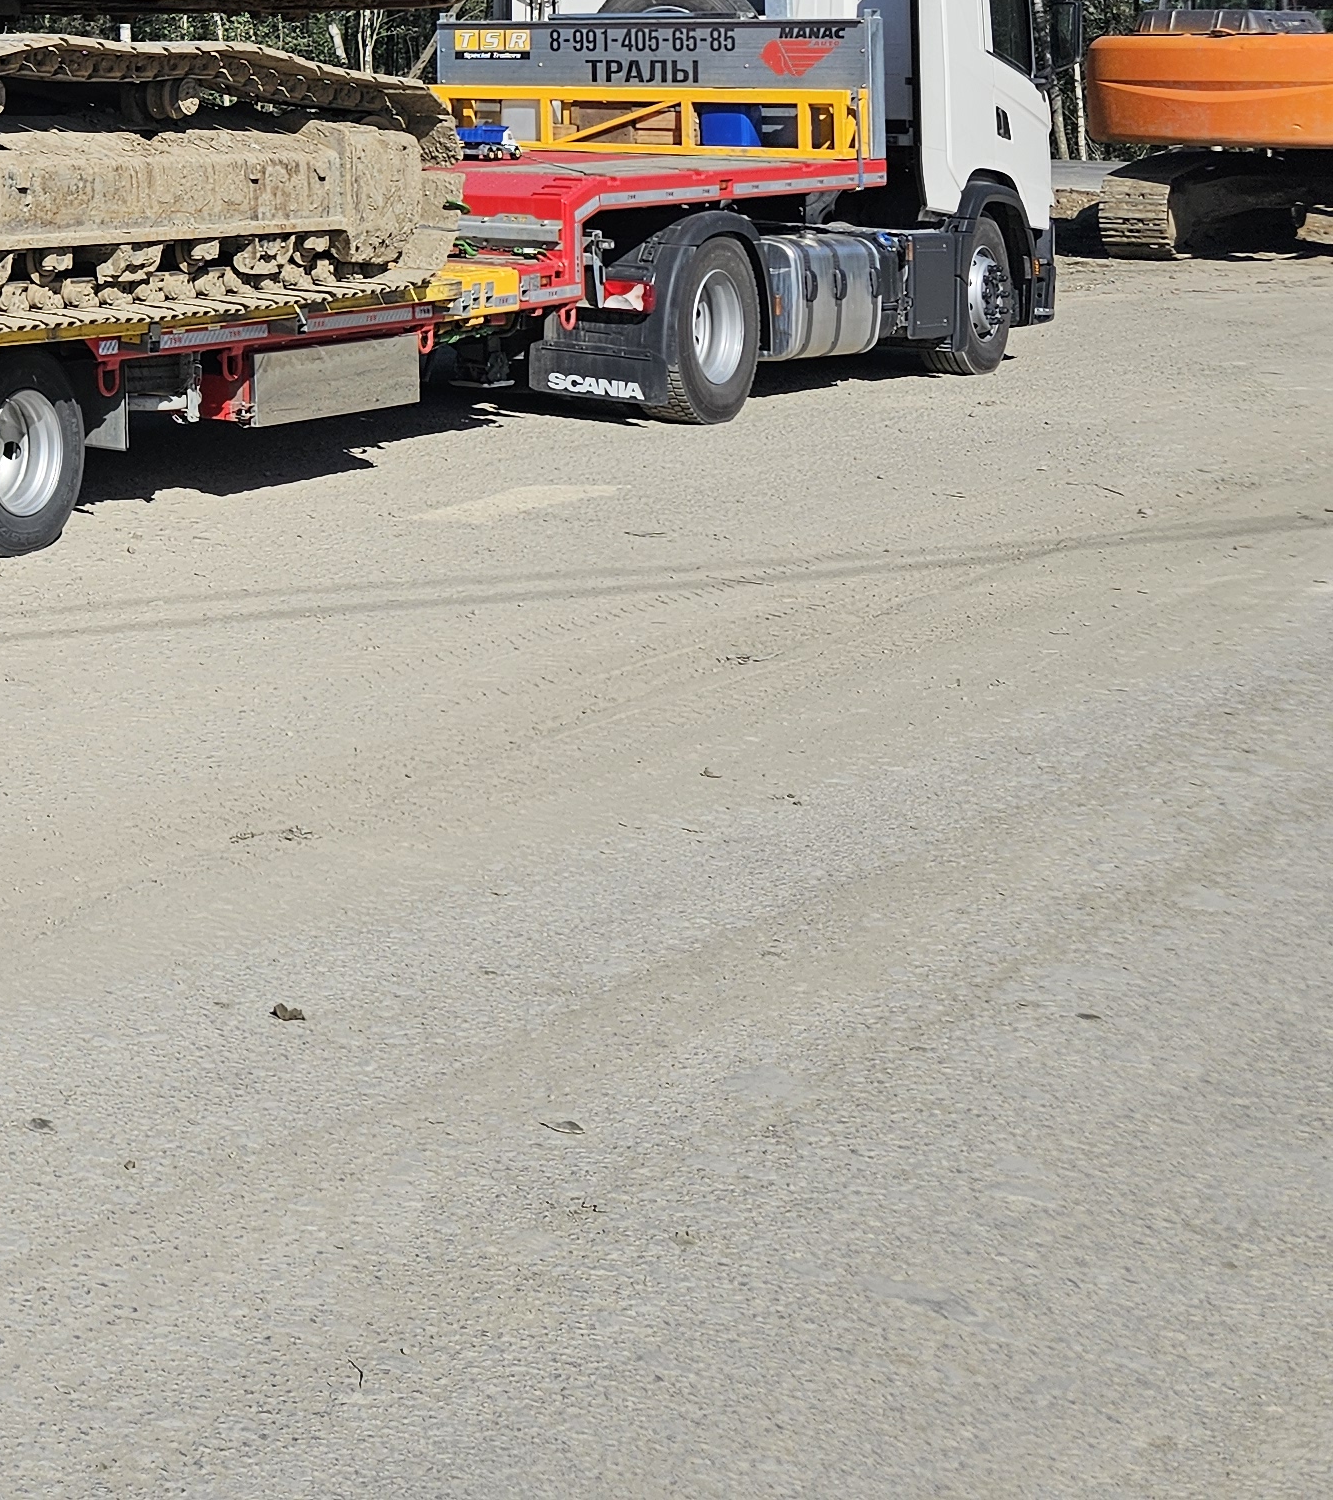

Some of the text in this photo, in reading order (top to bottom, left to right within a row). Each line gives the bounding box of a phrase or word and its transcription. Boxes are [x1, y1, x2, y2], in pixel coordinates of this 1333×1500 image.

[459, 31, 528, 49] TSR
[549, 28, 736, 52] 8-991-405-65-85
[779, 27, 846, 39] MANAC
[585, 59, 699, 83] ТРАЛЫ
[547, 372, 645, 400] SCANIA
